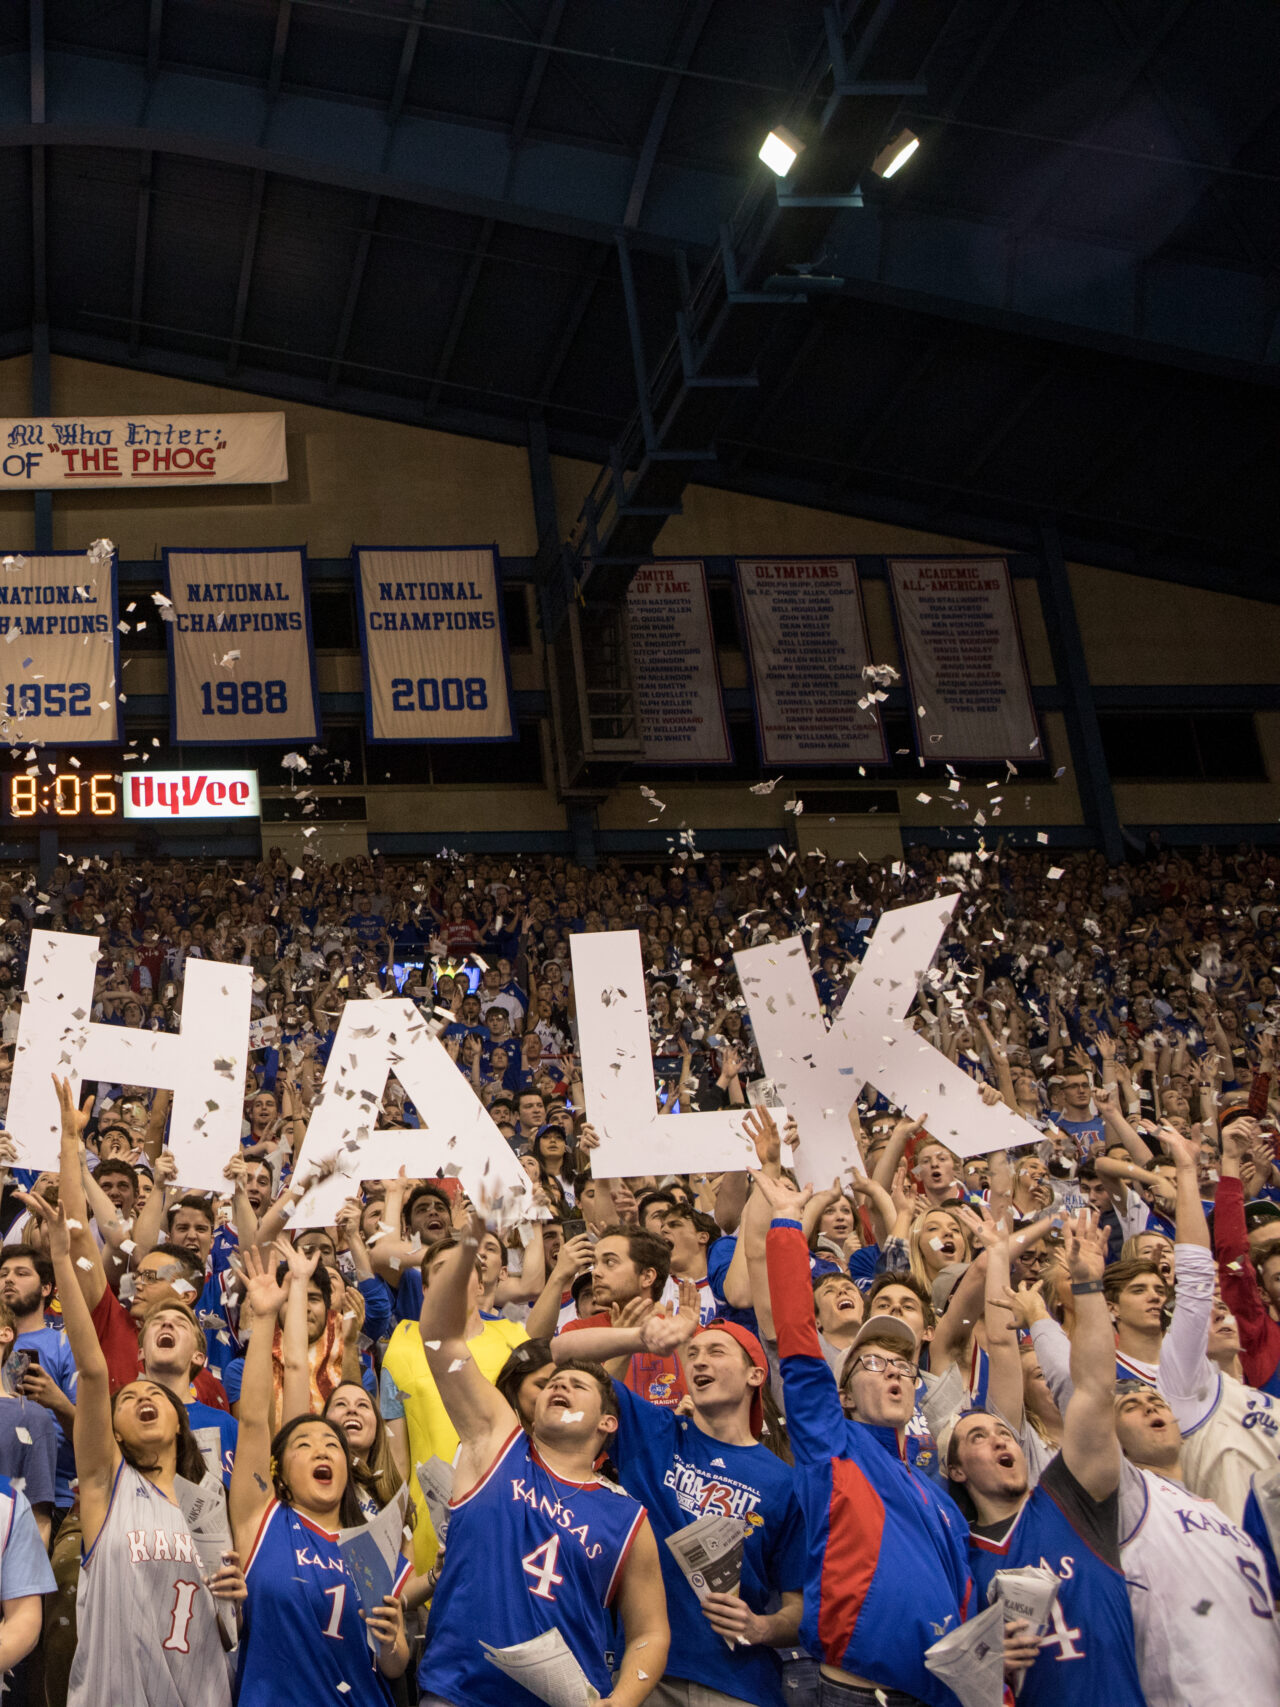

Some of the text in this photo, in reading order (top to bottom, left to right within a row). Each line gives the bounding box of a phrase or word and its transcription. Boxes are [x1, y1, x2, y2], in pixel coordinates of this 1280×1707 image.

[8, 424, 45, 448] All
[52, 423, 111, 446] Who
[125, 423, 222, 448] Enter:
[3, 453, 43, 478] OF
[635, 570, 674, 581] SMITH
[755, 566, 839, 578] OLYMPIANS
[919, 568, 979, 579] ACADEMIC
[187, 583, 289, 602] NATIONAL
[378, 582, 482, 600] NATIONAL
[637, 582, 691, 593] OF FAME
[903, 580, 1000, 591] ALL-AMERICANS
[175, 612, 302, 632] CHAMPIONS
[369, 611, 495, 631] CHAMPIONS
[5, 683, 92, 717] 1952
[201, 680, 287, 715] 1988
[391, 677, 488, 711] 2008
[12, 775, 116, 816] 8:06
[510, 1478, 603, 1560] KANSAS
[1174, 1508, 1256, 1551] KANS
[295, 1547, 350, 1575] KAN
[522, 1533, 564, 1602] 4
[322, 1584, 346, 1640] 1
